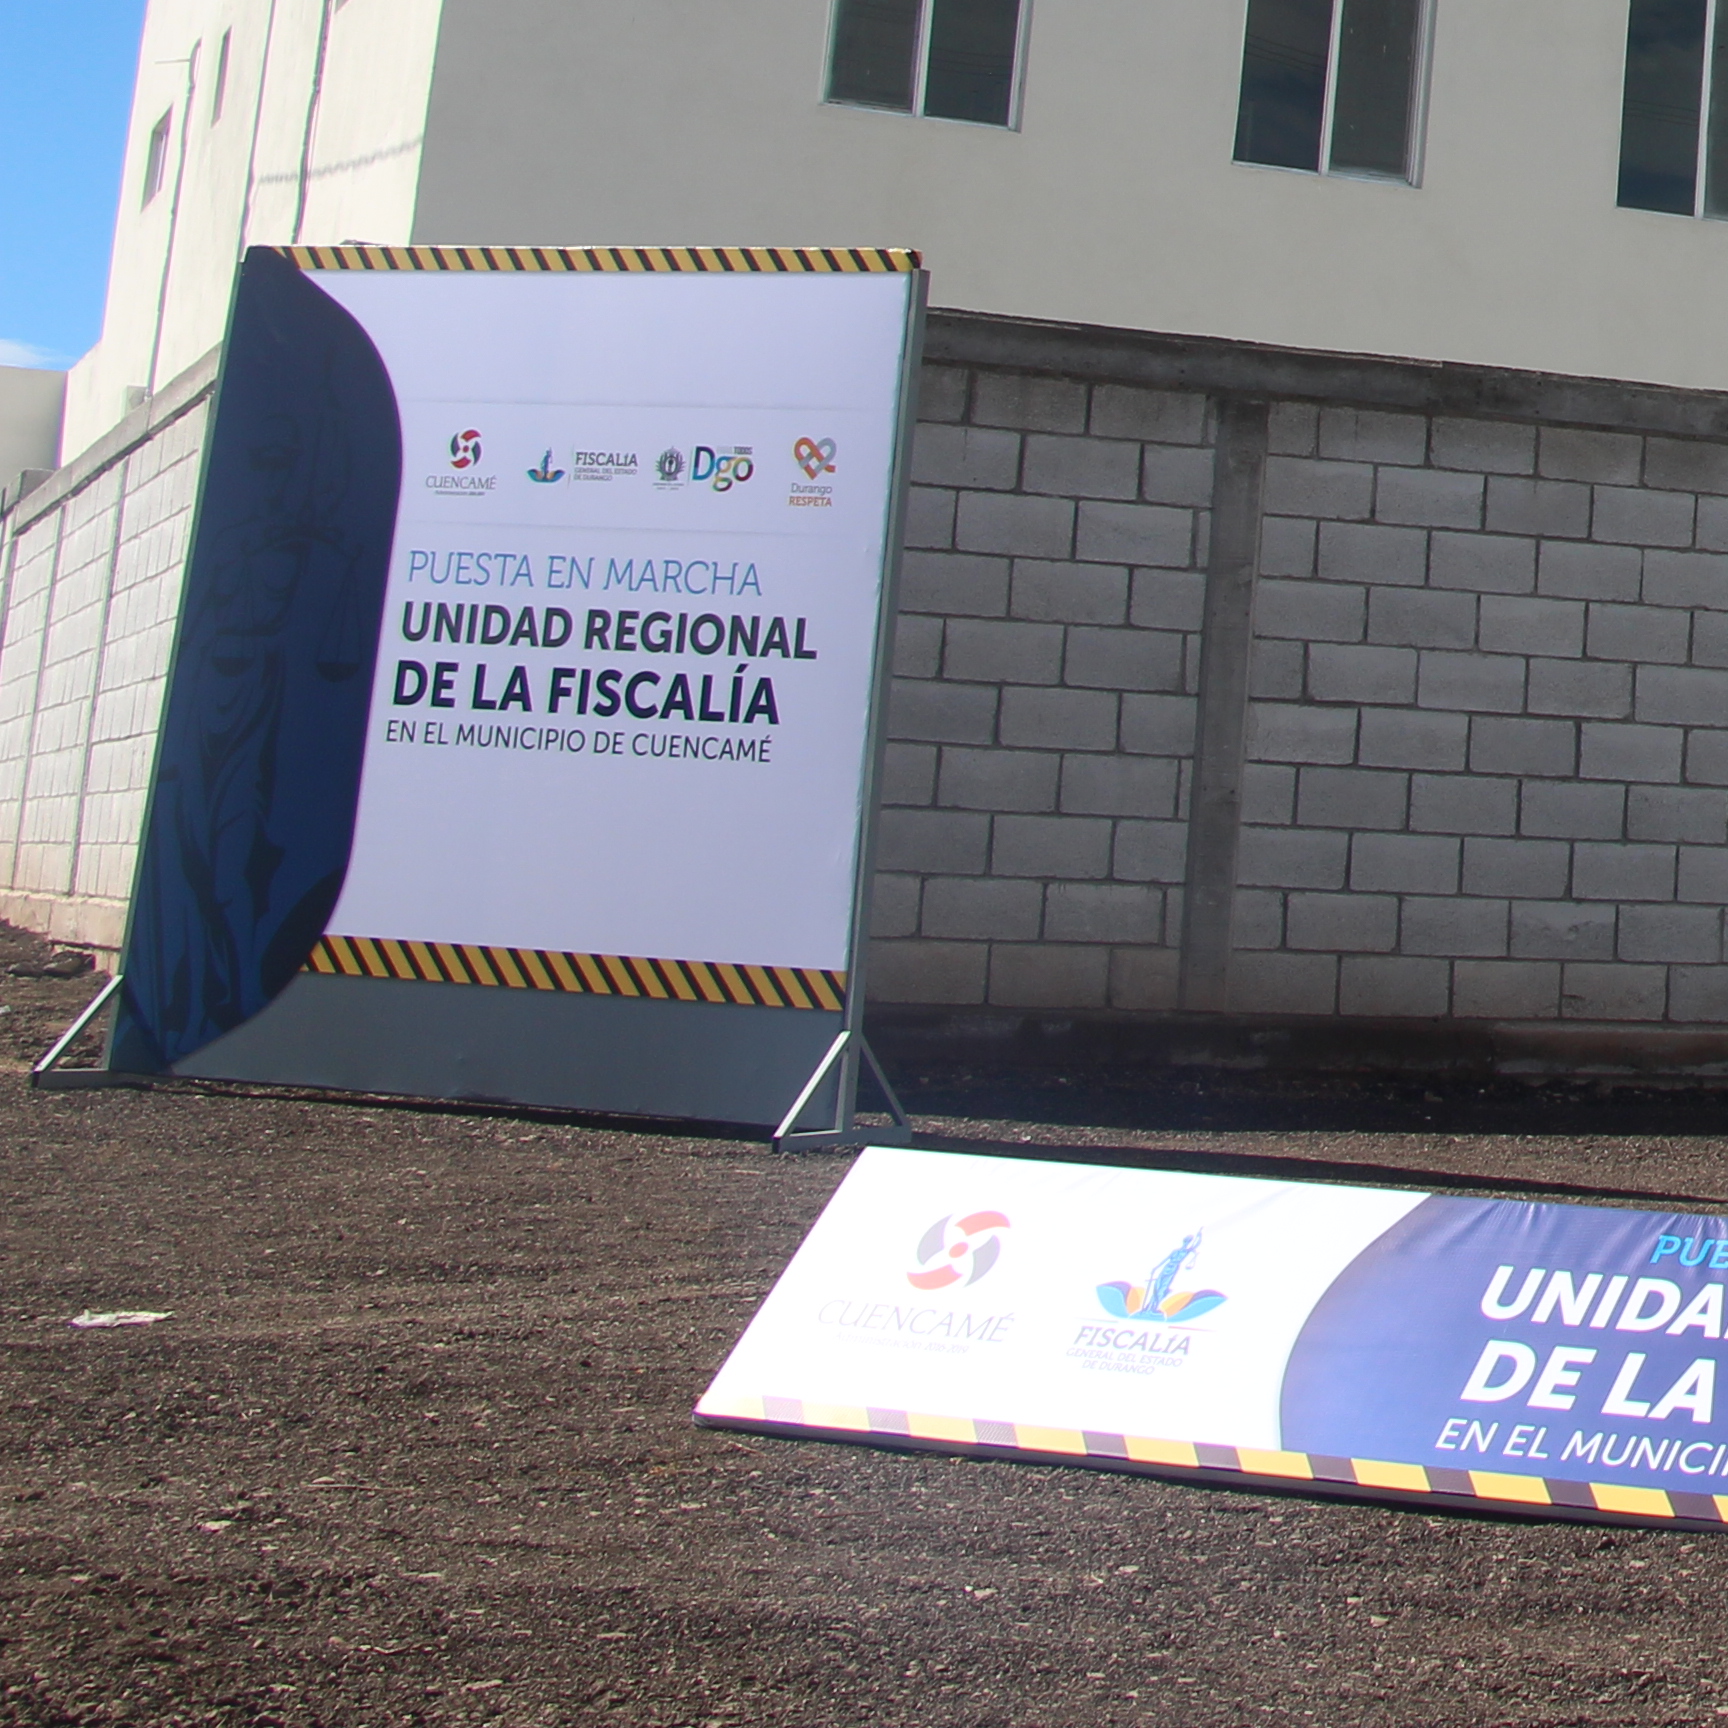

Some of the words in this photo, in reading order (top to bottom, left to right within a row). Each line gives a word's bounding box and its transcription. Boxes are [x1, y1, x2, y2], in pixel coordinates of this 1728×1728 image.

[425, 474, 497, 490] CUENCAMÉ
[692, 446, 754, 492] Dgo
[790, 482, 833, 496] Durango
[788, 495, 833, 508] RESPETA
[406, 550, 534, 588] PUESTA
[546, 555, 595, 590] EN
[602, 559, 763, 597] MARCHA
[401, 600, 573, 649] UNIDAD
[584, 608, 818, 661] REGIONAL
[392, 659, 460, 708] DE
[470, 663, 533, 713] LA
[547, 663, 780, 726] FISCALÍA
[385, 720, 417, 744] EN
[422, 721, 449, 746] EL
[455, 723, 586, 754] MUNICIPIO
[593, 731, 625, 756] DE
[631, 733, 773, 764] CUENCAMÉ
[817, 1298, 1015, 1343] CUENCAMÉ
[1065, 1347, 1114, 1361] GENERAL
[1117, 1352, 1136, 1363] DEL
[1139, 1354, 1183, 1368] ESTADO
[1081, 1359, 1098, 1370] DE
[1098, 1360, 1156, 1376] DURANGO
[1459, 1339, 1598, 1411] DE
[1600, 1352, 1717, 1424] LA
[1434, 1417, 1499, 1453] EN
[1502, 1424, 1549, 1459] EL
